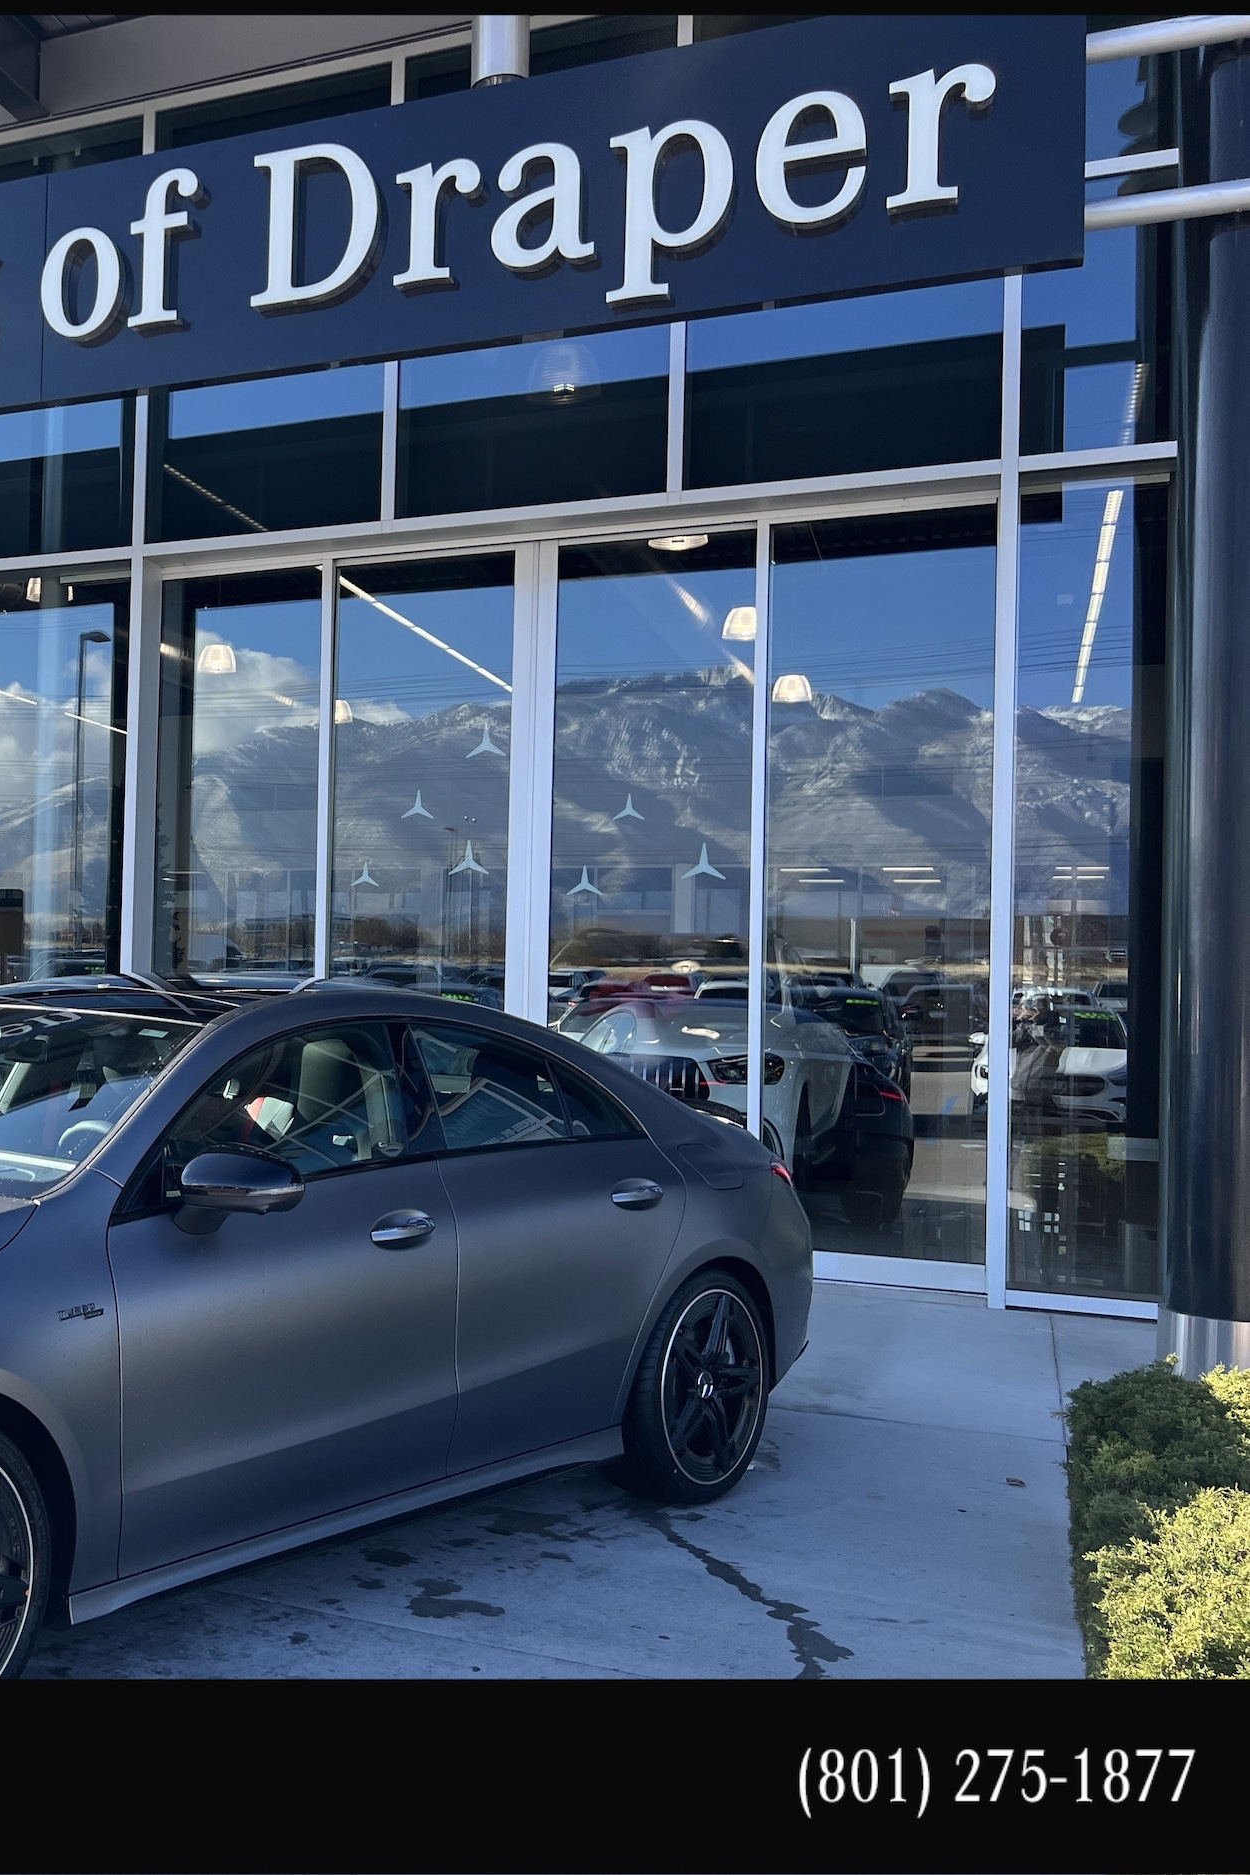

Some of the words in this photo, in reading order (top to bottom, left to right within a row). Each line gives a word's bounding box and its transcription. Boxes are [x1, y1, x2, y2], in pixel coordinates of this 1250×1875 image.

[40, 167, 199, 338] of
[250, 62, 997, 307] Draper
[57, 1303, 95, 1318] TURBO
